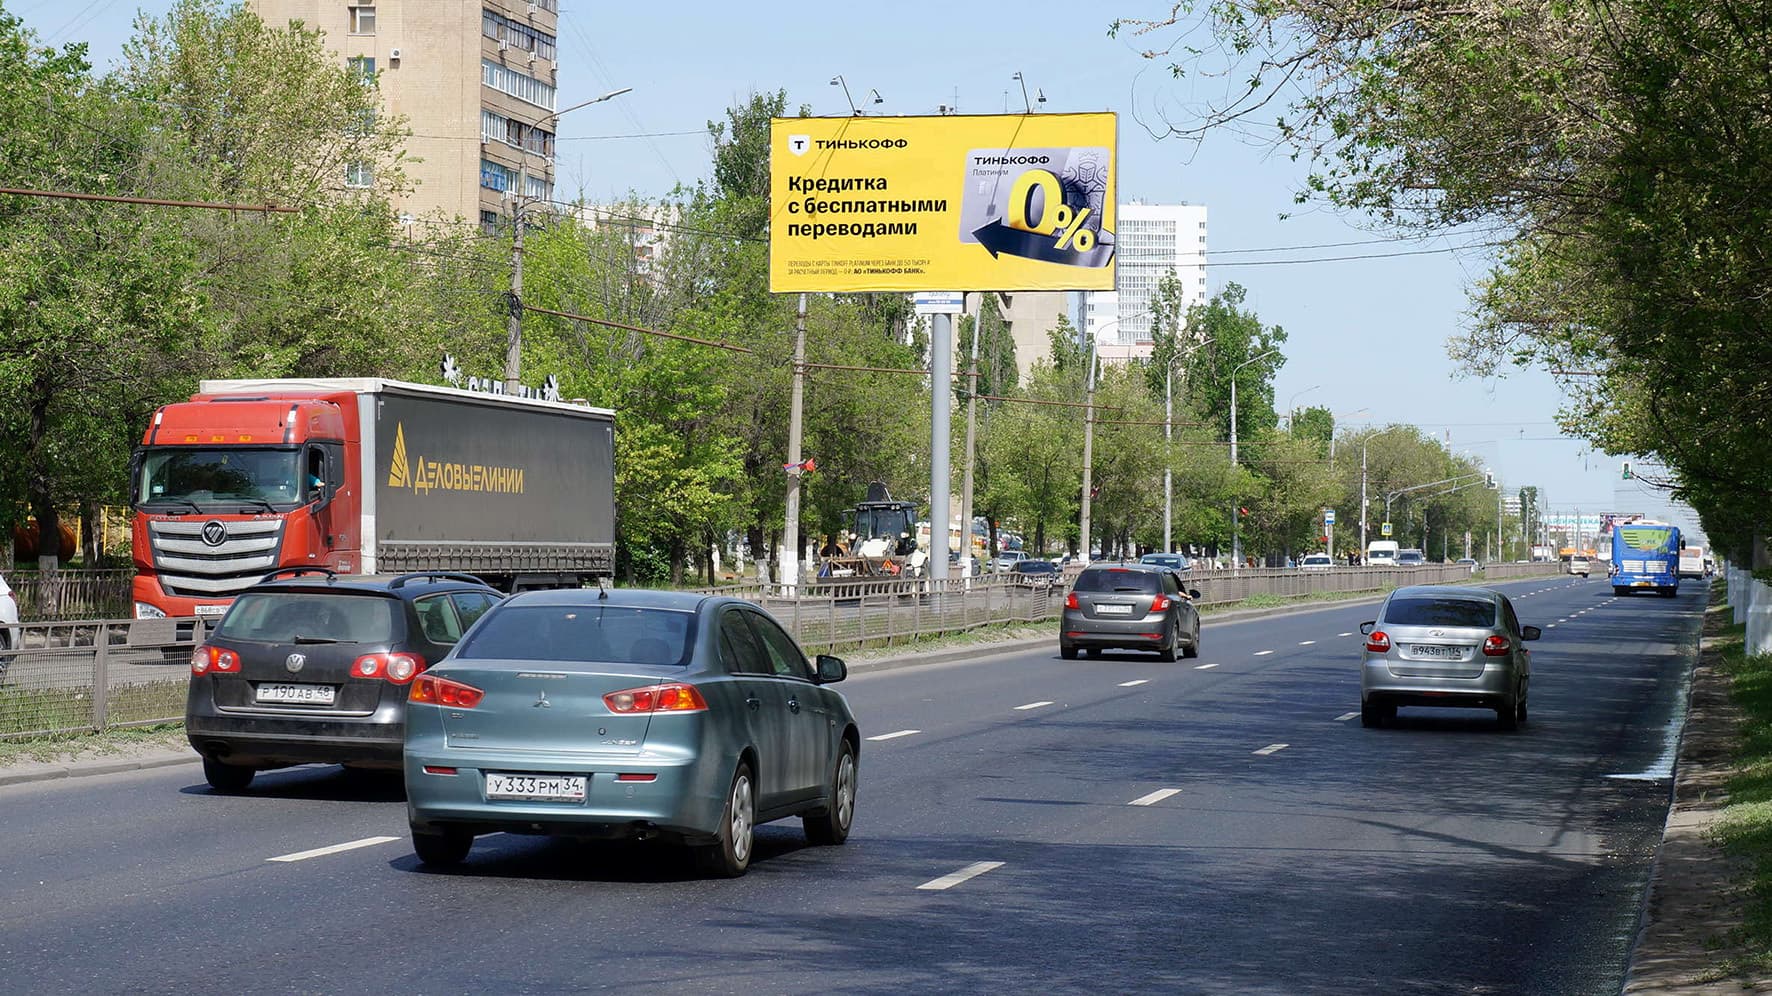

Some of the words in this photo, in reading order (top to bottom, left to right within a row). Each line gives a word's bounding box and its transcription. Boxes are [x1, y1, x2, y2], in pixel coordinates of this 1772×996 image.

[815, 139, 908, 149] ТИНЬКОФФ
[974, 156, 1050, 165] ТИНЬКОФФ
[789, 176, 887, 194] Кредитка
[788, 201, 800, 214] с
[804, 197, 947, 214] бесплатными
[1008, 168, 1095, 252] 0%
[788, 222, 917, 239] переводами
